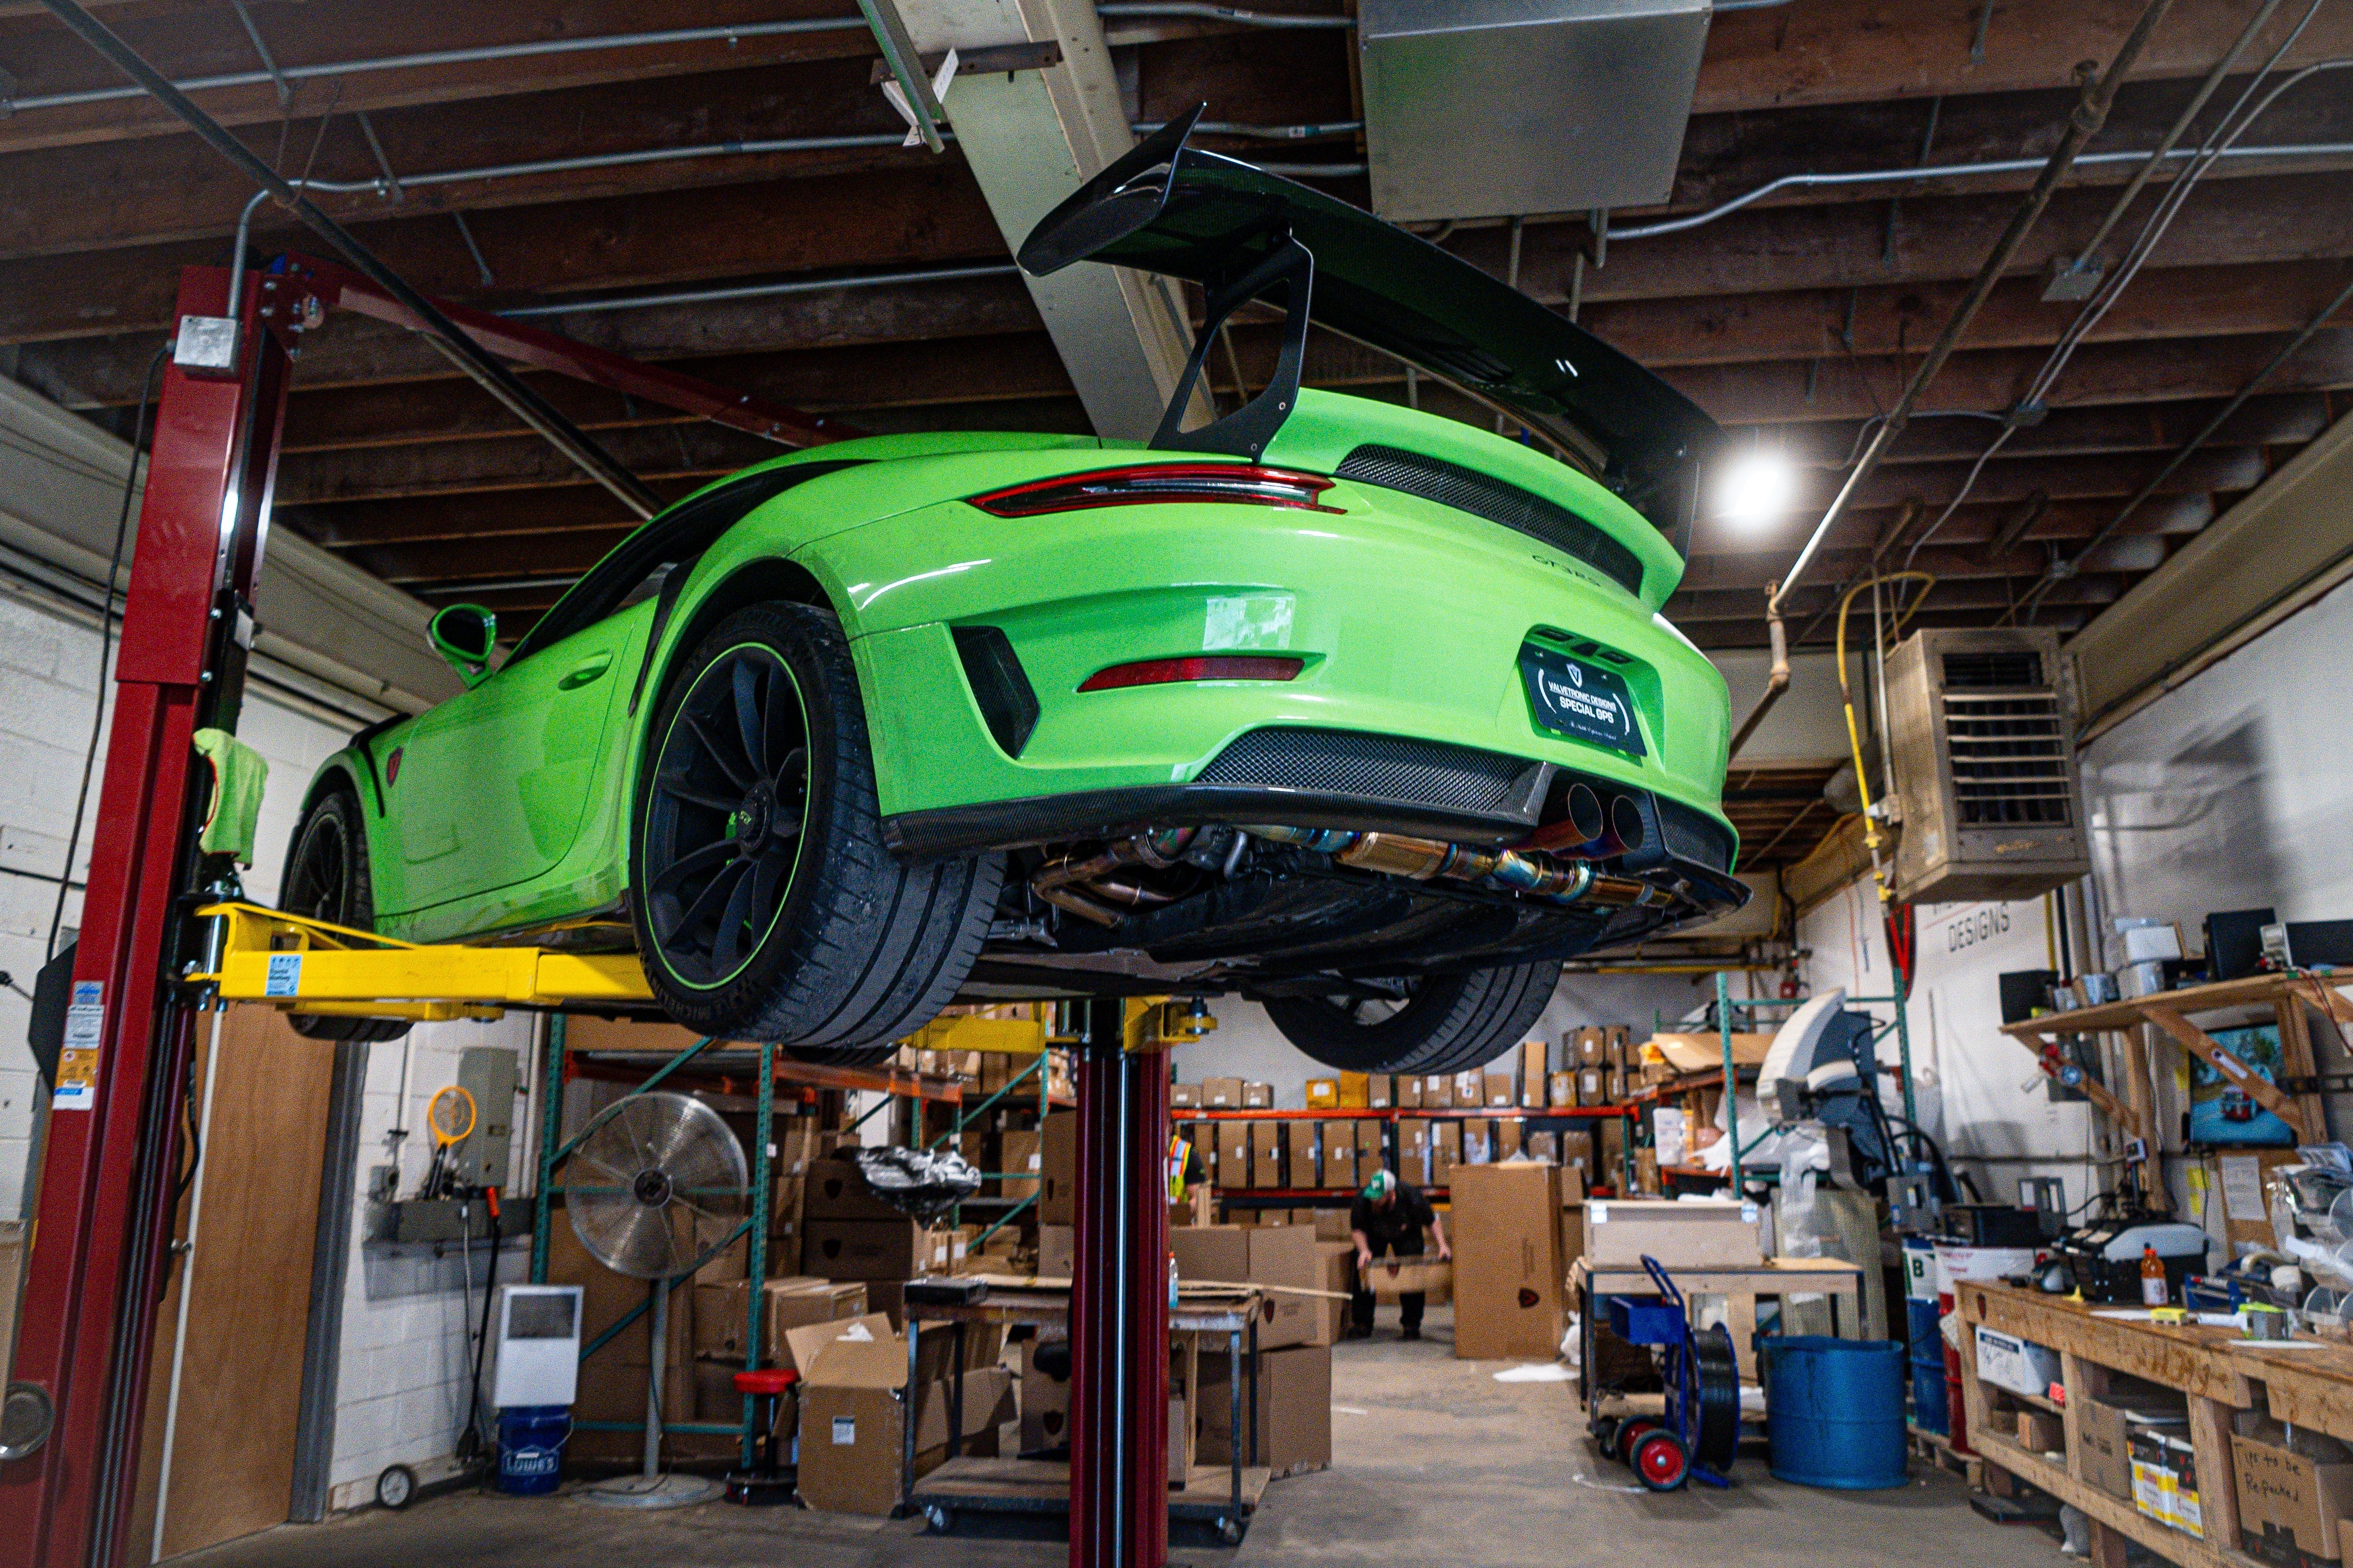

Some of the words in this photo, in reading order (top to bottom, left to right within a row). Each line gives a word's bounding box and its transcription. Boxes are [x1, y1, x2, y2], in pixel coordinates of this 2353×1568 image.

[1548, 681, 1590, 703] VALVETRONIC
[1591, 695, 1616, 711] DESIGNS
[1559, 696, 1596, 718] SPECIAL
[1596, 708, 1614, 724] OPS
[1947, 902, 2010, 952] DESIGNS
[1912, 1258, 1924, 1278] B
